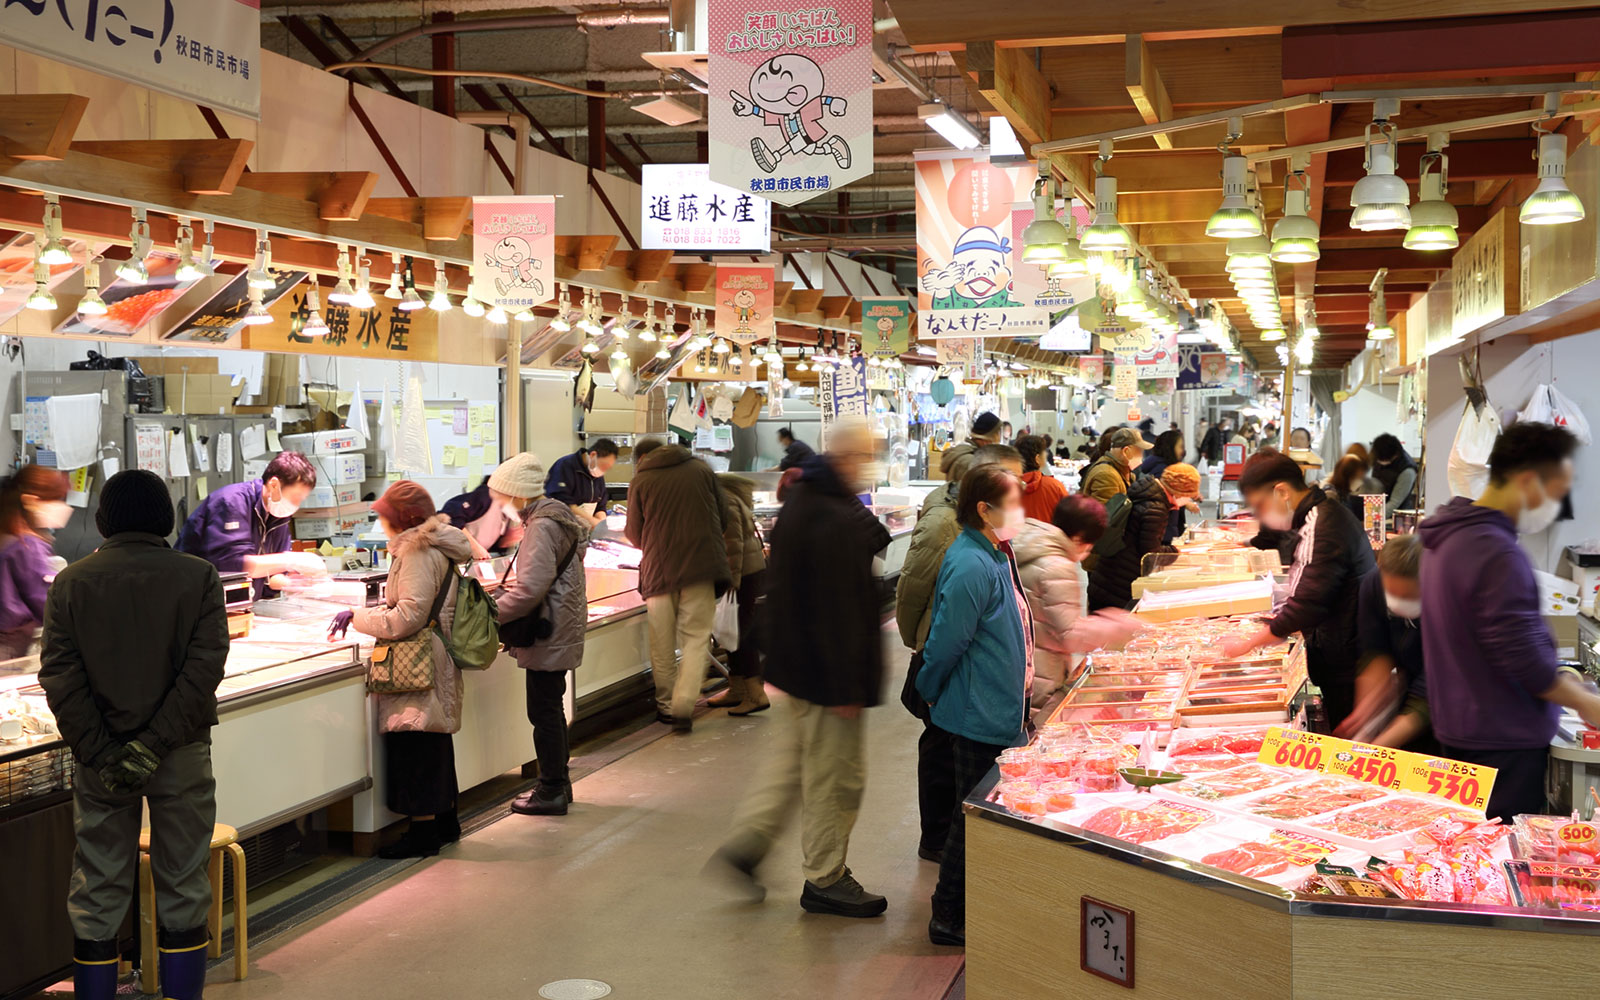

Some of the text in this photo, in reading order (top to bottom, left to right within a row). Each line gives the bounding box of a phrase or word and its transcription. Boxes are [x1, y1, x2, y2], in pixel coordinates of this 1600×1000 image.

[746, 10, 839, 32] 笑顔 いちばん
[728, 32, 783, 51] おいしさ
[175, 35, 250, 80] 秋田市民市場
[749, 175, 830, 191] 秋田市民市場
[649, 193, 756, 223] 進藤水産
[673, 227, 690, 236] 018
[718, 227, 740, 236] 1816
[673, 236, 690, 244] 018
[693, 236, 712, 244] 884
[717, 236, 742, 244] 7022
[287, 293, 413, 352] 進藤水産
[925, 312, 1007, 336] なんもだー!
[1266, 738, 1281, 748] 100g
[1333, 762, 1348, 773] 100g
[1412, 767, 1429, 778] 100g
